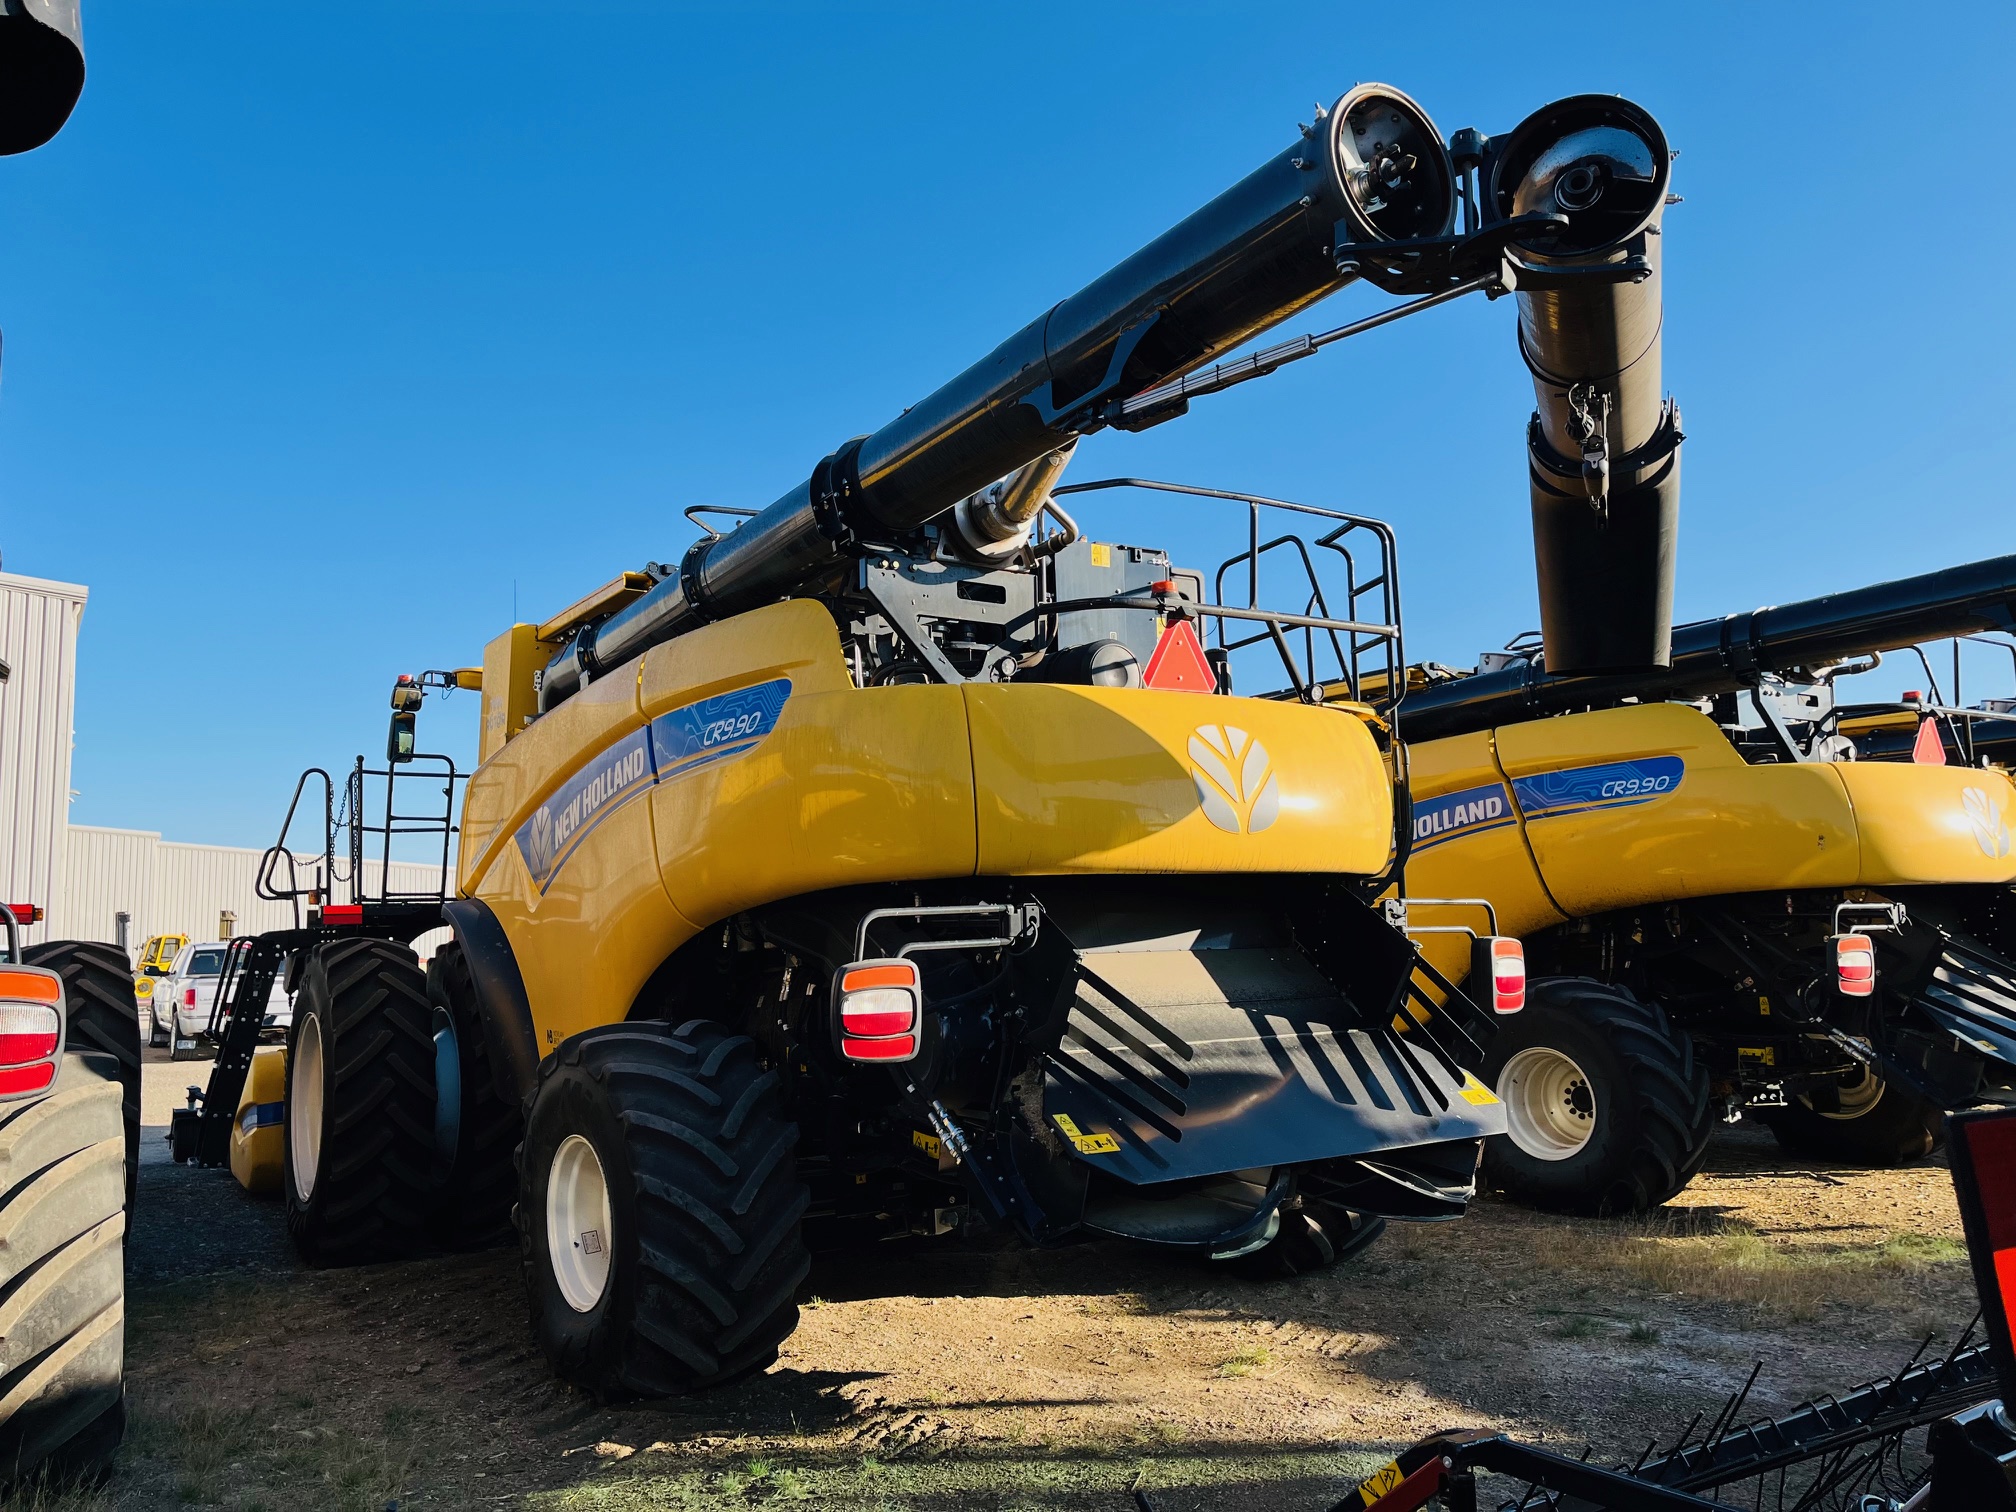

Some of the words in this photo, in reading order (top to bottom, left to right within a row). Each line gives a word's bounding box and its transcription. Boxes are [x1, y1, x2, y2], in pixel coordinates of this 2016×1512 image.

[703, 711, 761, 747] CR9.90
[554, 795, 581, 850] NEW
[581, 747, 644, 816] HOLLAND
[1601, 776, 1670, 798] CR9.90
